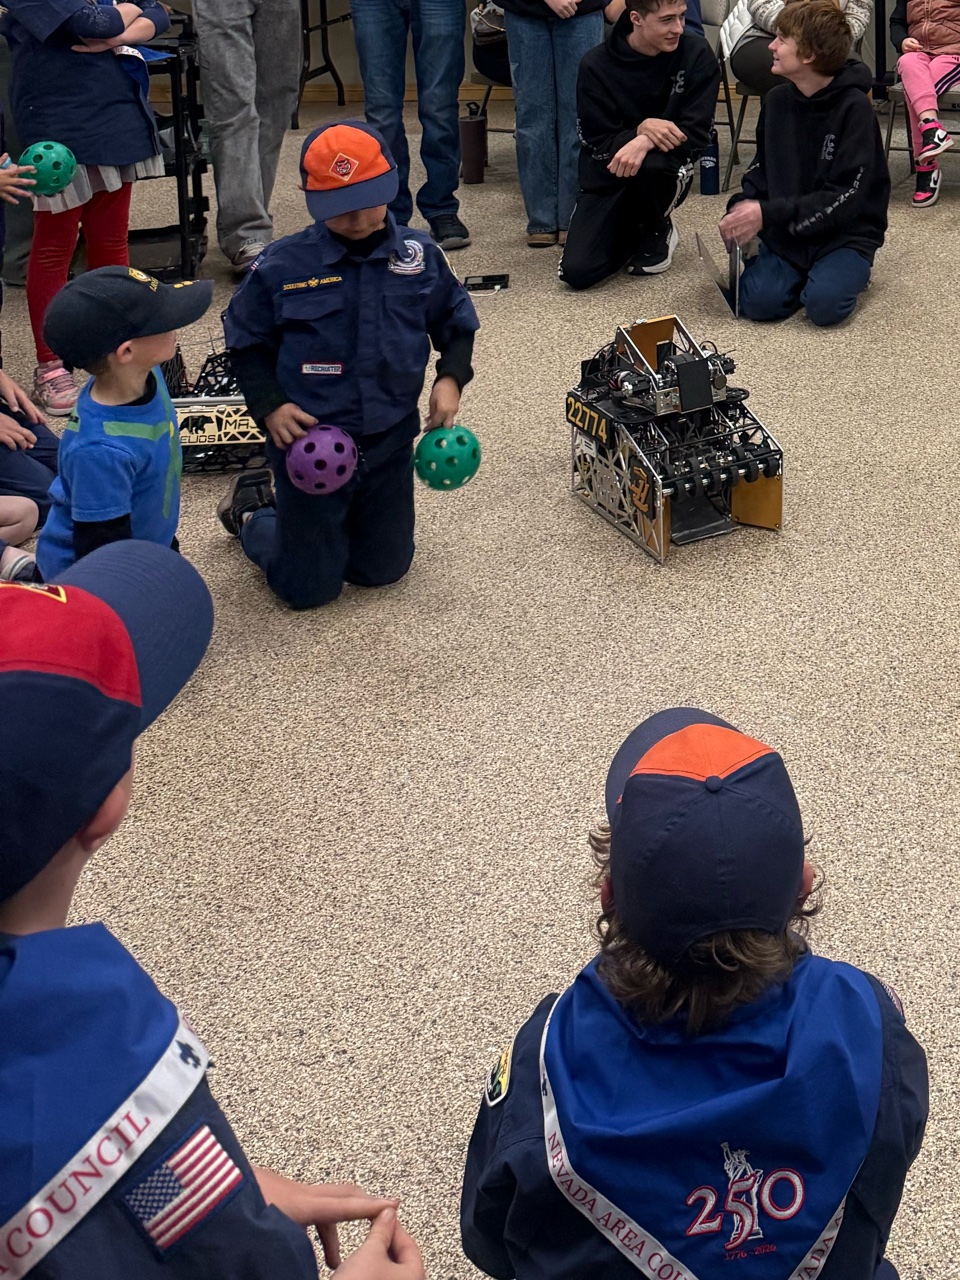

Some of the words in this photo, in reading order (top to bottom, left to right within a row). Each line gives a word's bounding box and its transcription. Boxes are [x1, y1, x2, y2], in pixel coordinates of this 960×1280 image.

[283, 282, 307, 291] SCOUTING
[319, 276, 343, 284] AMERICA
[567, 396, 607, 443] 22774
[6, 1110, 152, 1259] COUNCIL
[548, 1132, 598, 1214] NEVADA
[597, 1212, 647, 1259] AREA
[685, 1167, 806, 1251] 250
[724, 1250, 748, 1261] 1776
[754, 1244, 777, 1256] 2026
